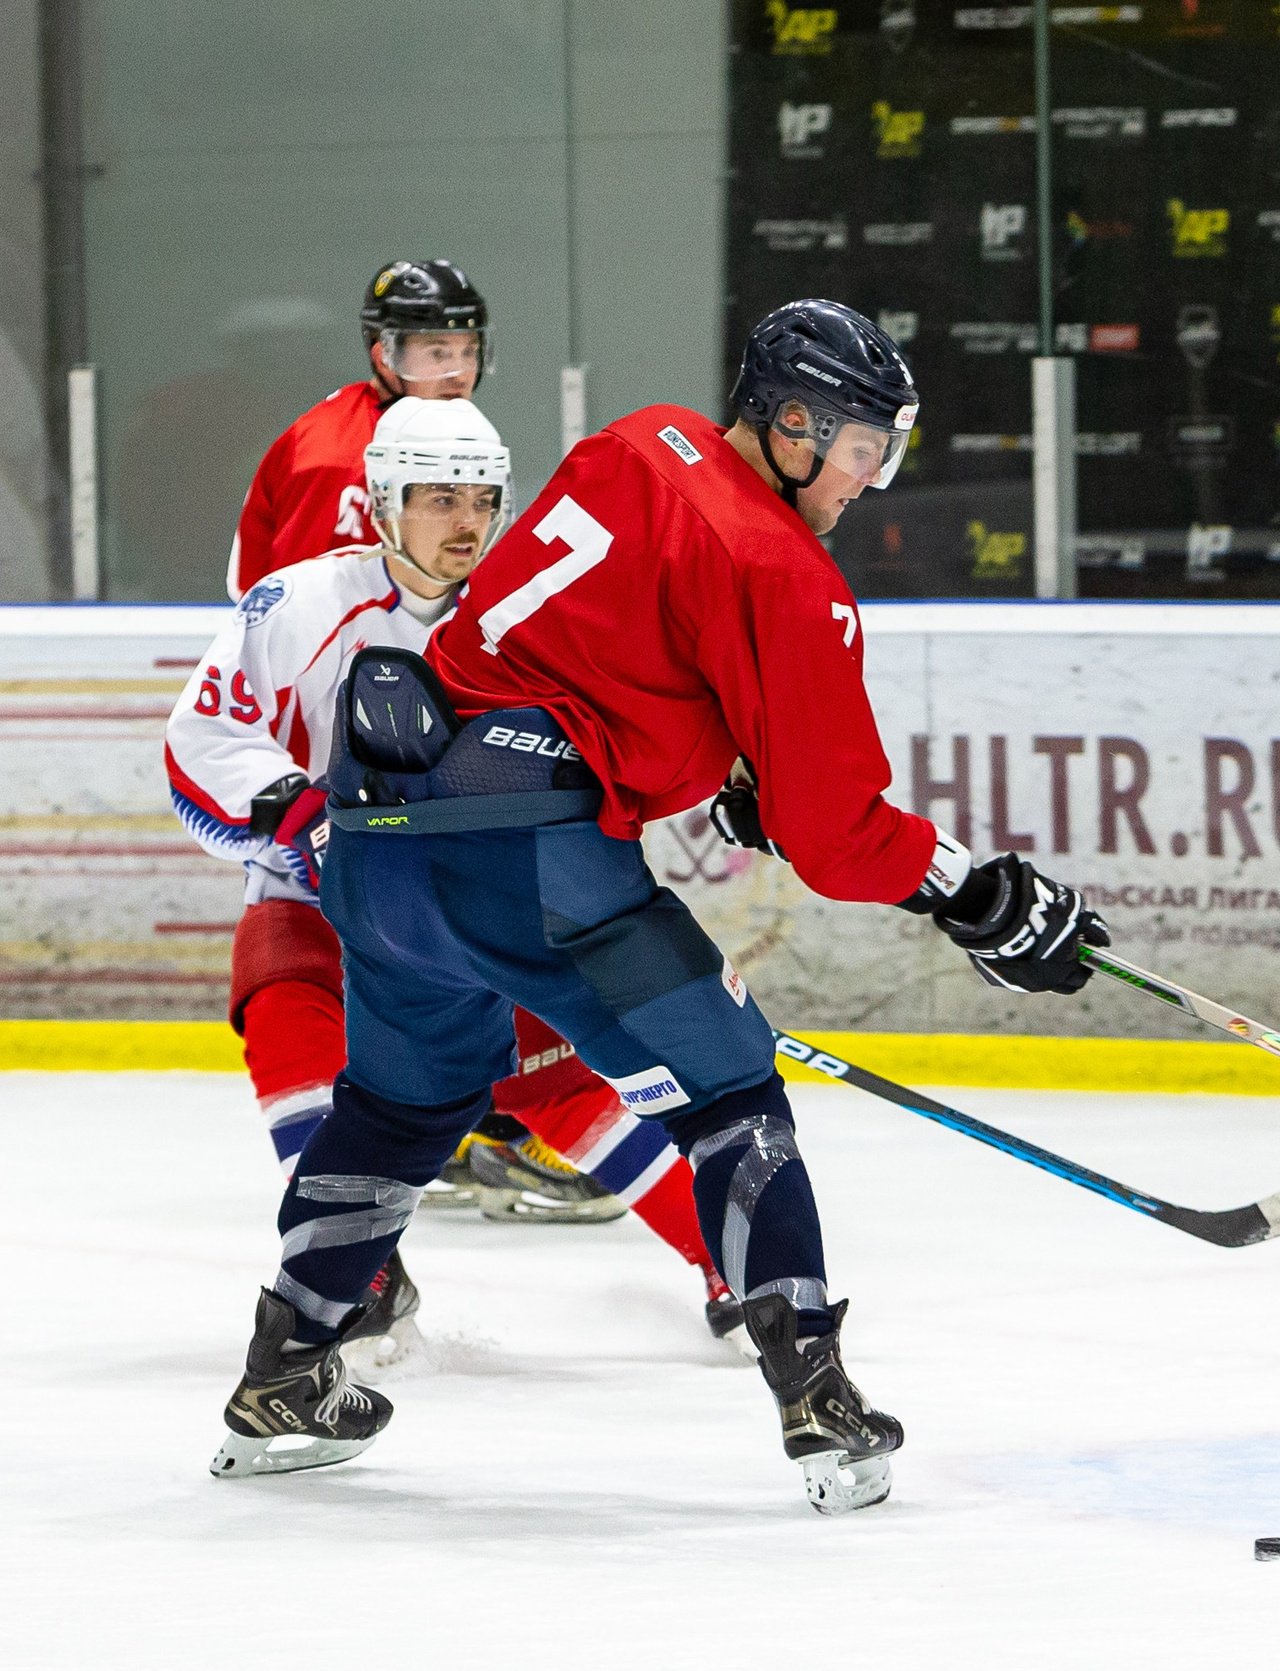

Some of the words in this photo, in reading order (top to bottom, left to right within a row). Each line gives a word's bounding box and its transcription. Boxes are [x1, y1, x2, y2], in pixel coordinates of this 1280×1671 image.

[796, 362, 842, 387] BAUER
[478, 494, 615, 656] 7
[831, 601, 858, 648] 7
[194, 665, 263, 725] 69
[483, 726, 582, 761] BAUE
[367, 816, 411, 827] VAPOR
[966, 877, 1055, 960] CCM
[523, 1043, 576, 1075] BAU
[268, 1398, 308, 1433] CCM
[825, 1398, 881, 1448] CCM
